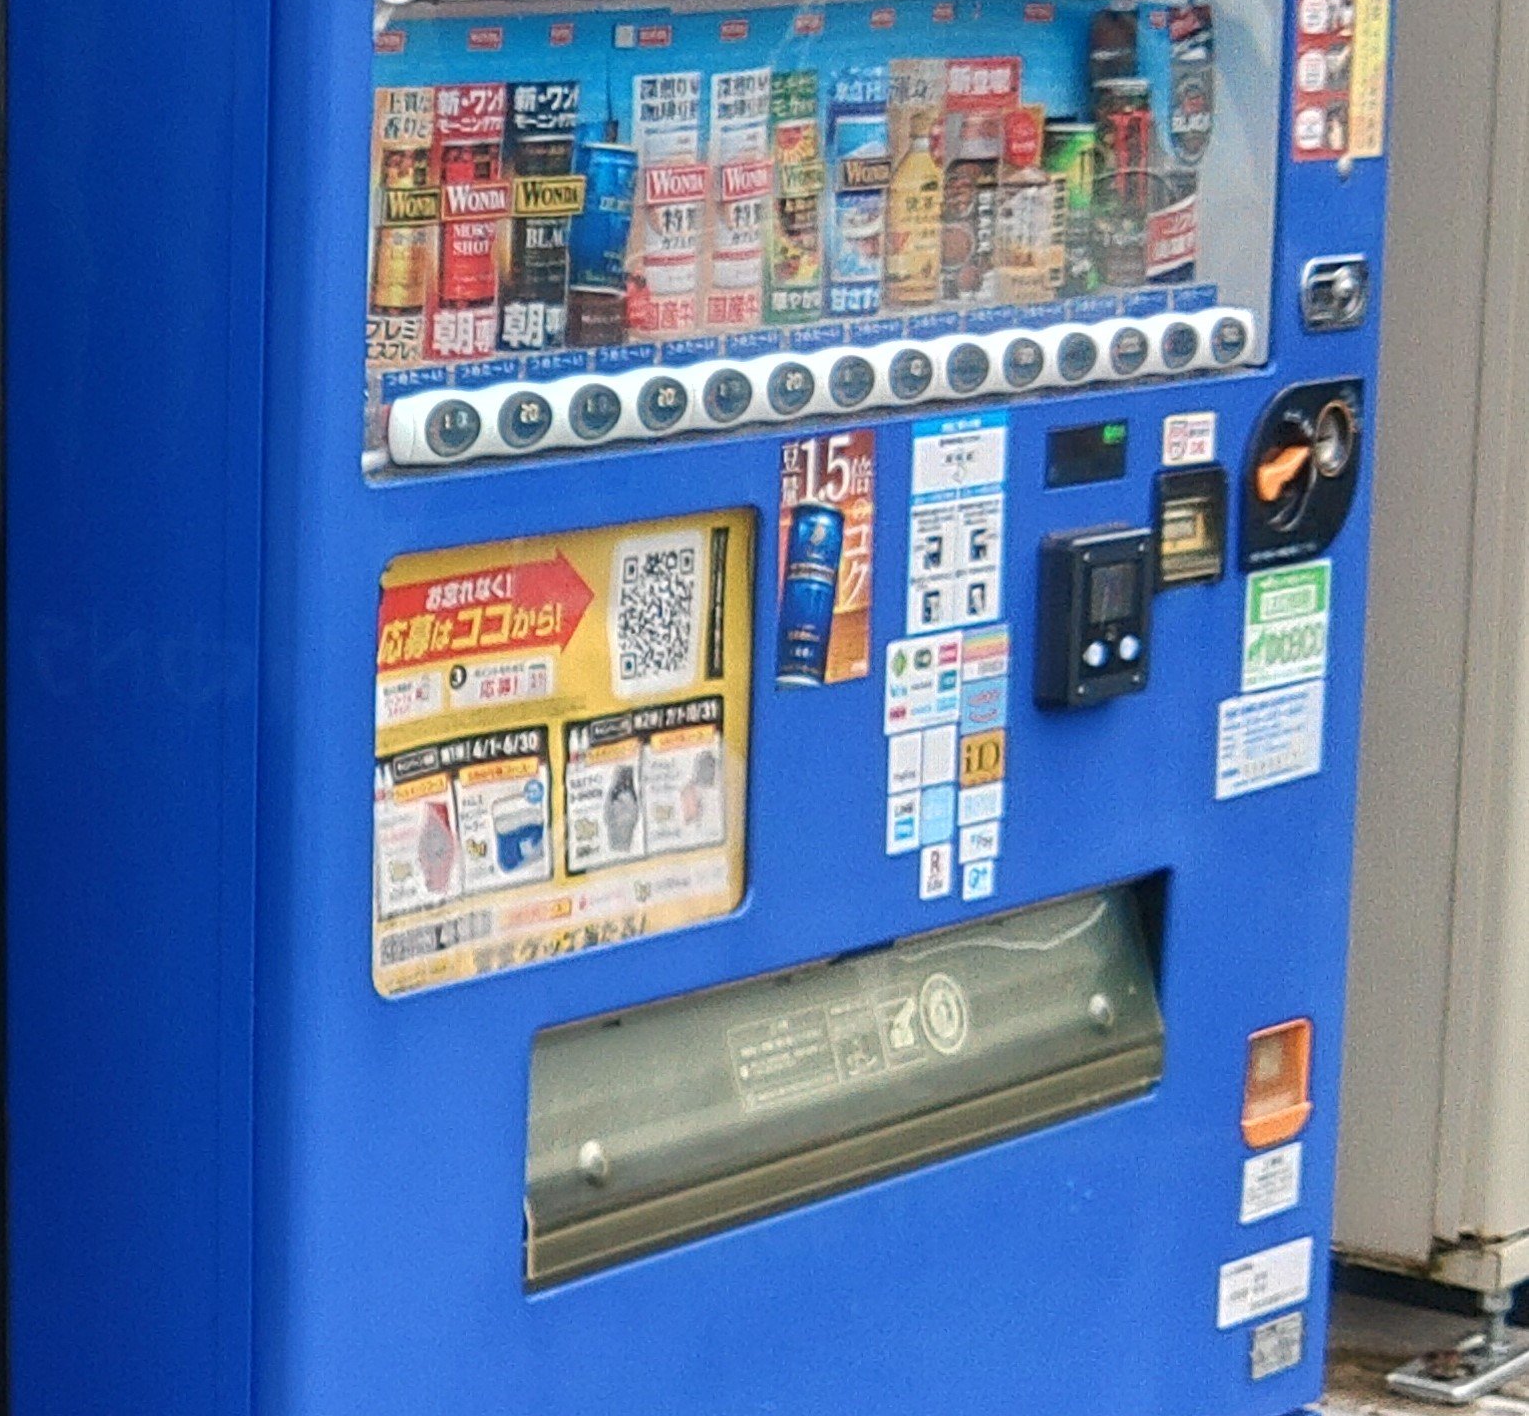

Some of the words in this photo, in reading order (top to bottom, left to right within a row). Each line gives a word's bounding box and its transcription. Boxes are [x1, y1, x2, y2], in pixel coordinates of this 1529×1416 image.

[447, 185, 507, 214] WONDA
[522, 180, 579, 205] WONDA
[802, 434, 853, 503] 1.5
[425, 573, 514, 612] お忘れなく!
[378, 601, 562, 665] 応募はココから!
